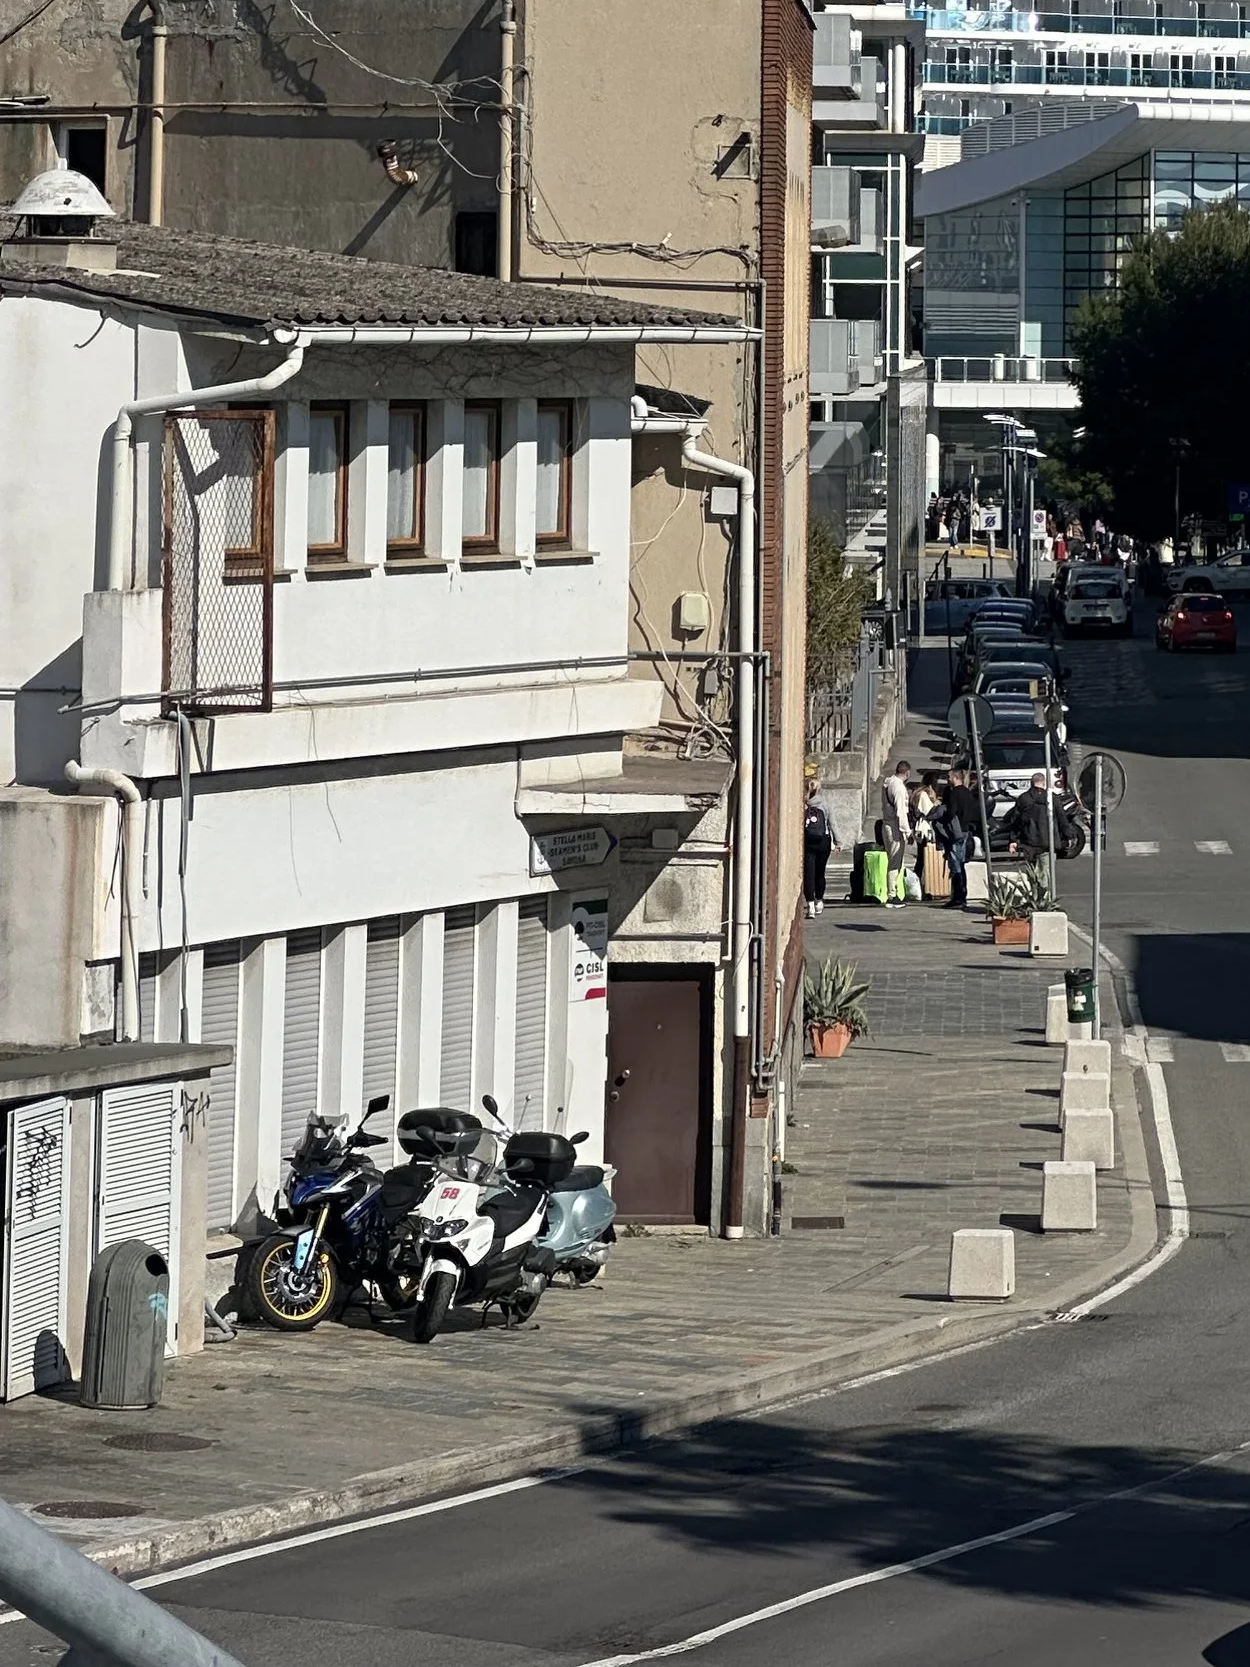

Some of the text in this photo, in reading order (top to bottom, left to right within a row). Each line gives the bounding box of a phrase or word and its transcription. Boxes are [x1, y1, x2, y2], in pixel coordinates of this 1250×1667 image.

[553, 835, 575, 845] STELLA
[586, 961, 604, 974] CISL
[440, 1187, 461, 1200] 58
